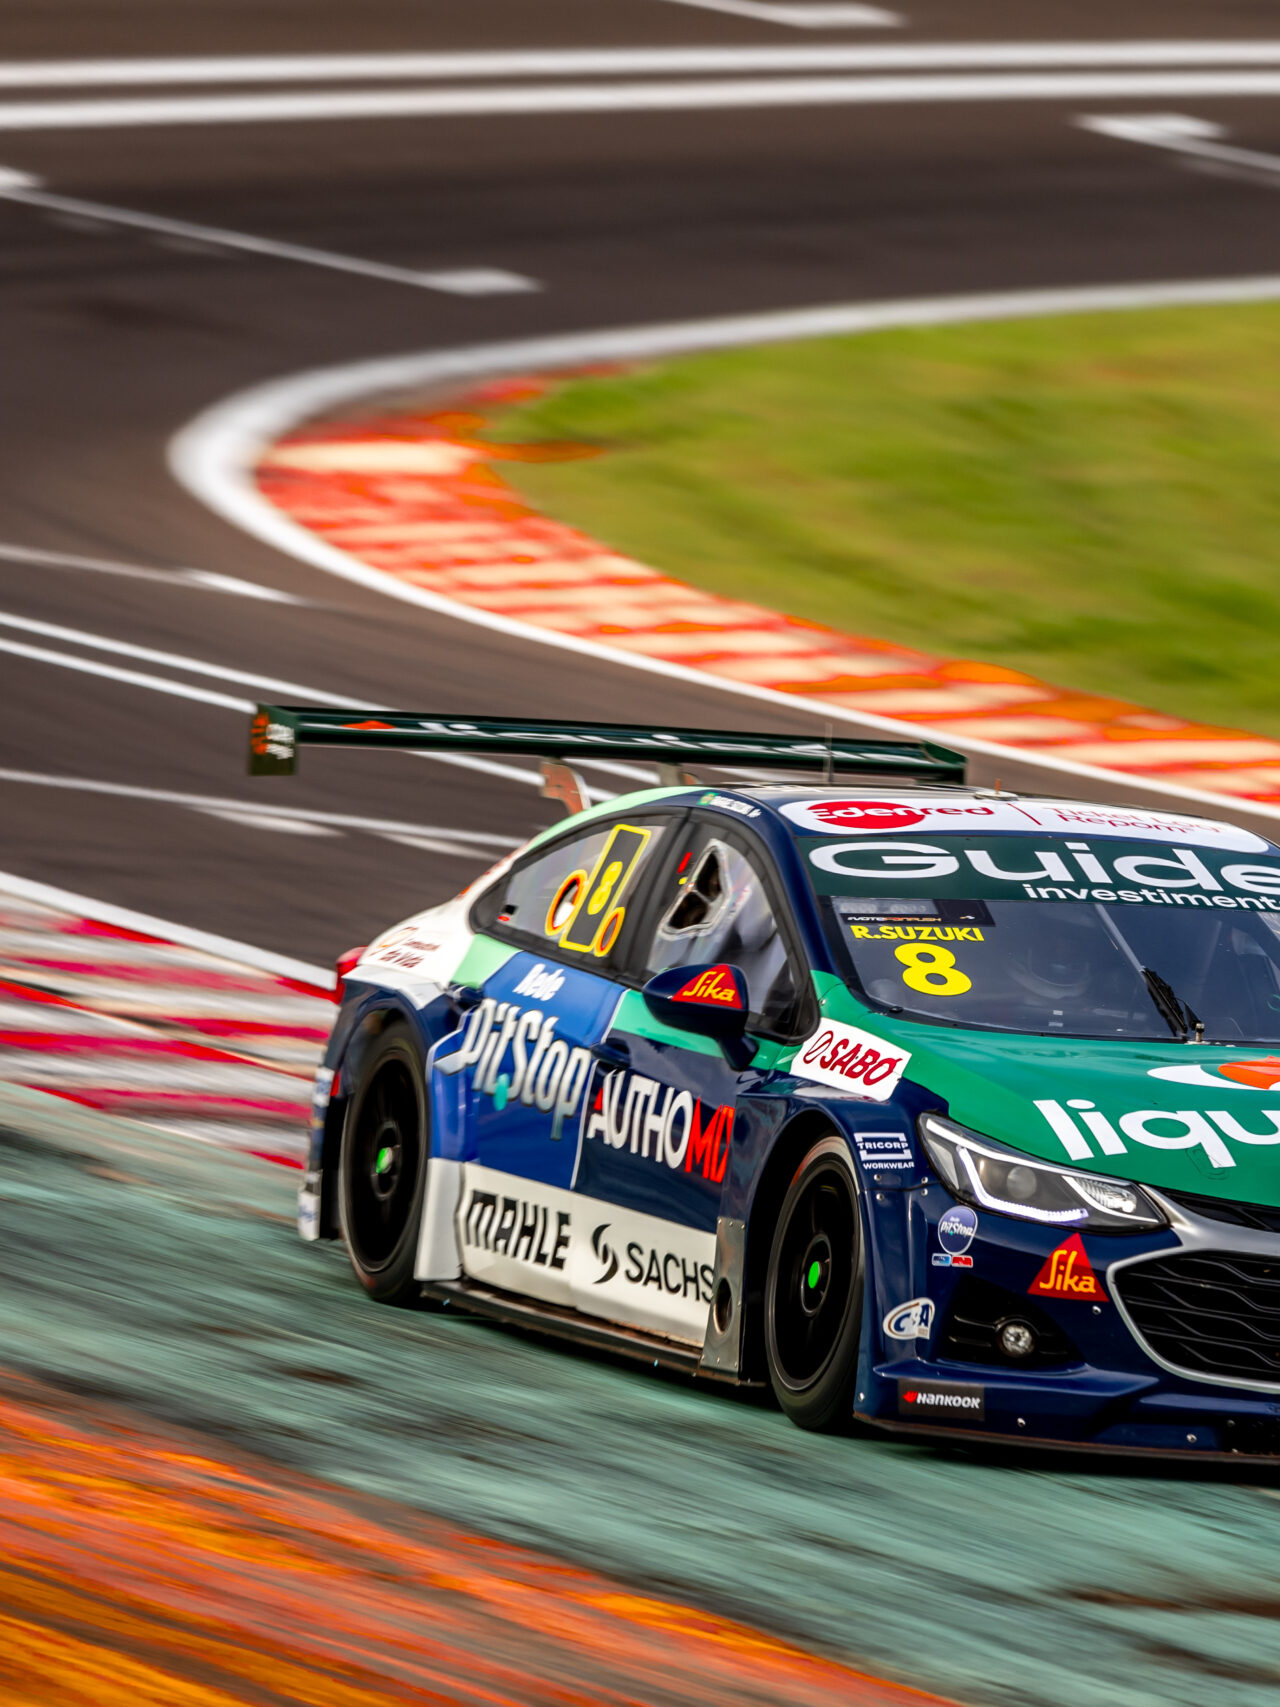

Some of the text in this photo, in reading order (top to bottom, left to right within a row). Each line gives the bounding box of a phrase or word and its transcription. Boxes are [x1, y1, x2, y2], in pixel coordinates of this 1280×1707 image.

[807, 805, 995, 819] Edenred
[587, 861, 623, 915] 8
[850, 925, 985, 942] R.SUZUKI
[682, 970, 736, 1002] Sika
[894, 942, 972, 996] 8
[857, 1141, 909, 1150] TRICORP
[863, 1161, 915, 1170] WORKWEAR
[466, 1188, 572, 1271] MAHLE
[624, 1242, 714, 1304] SACHS
[1039, 1250, 1096, 1293] Sika
